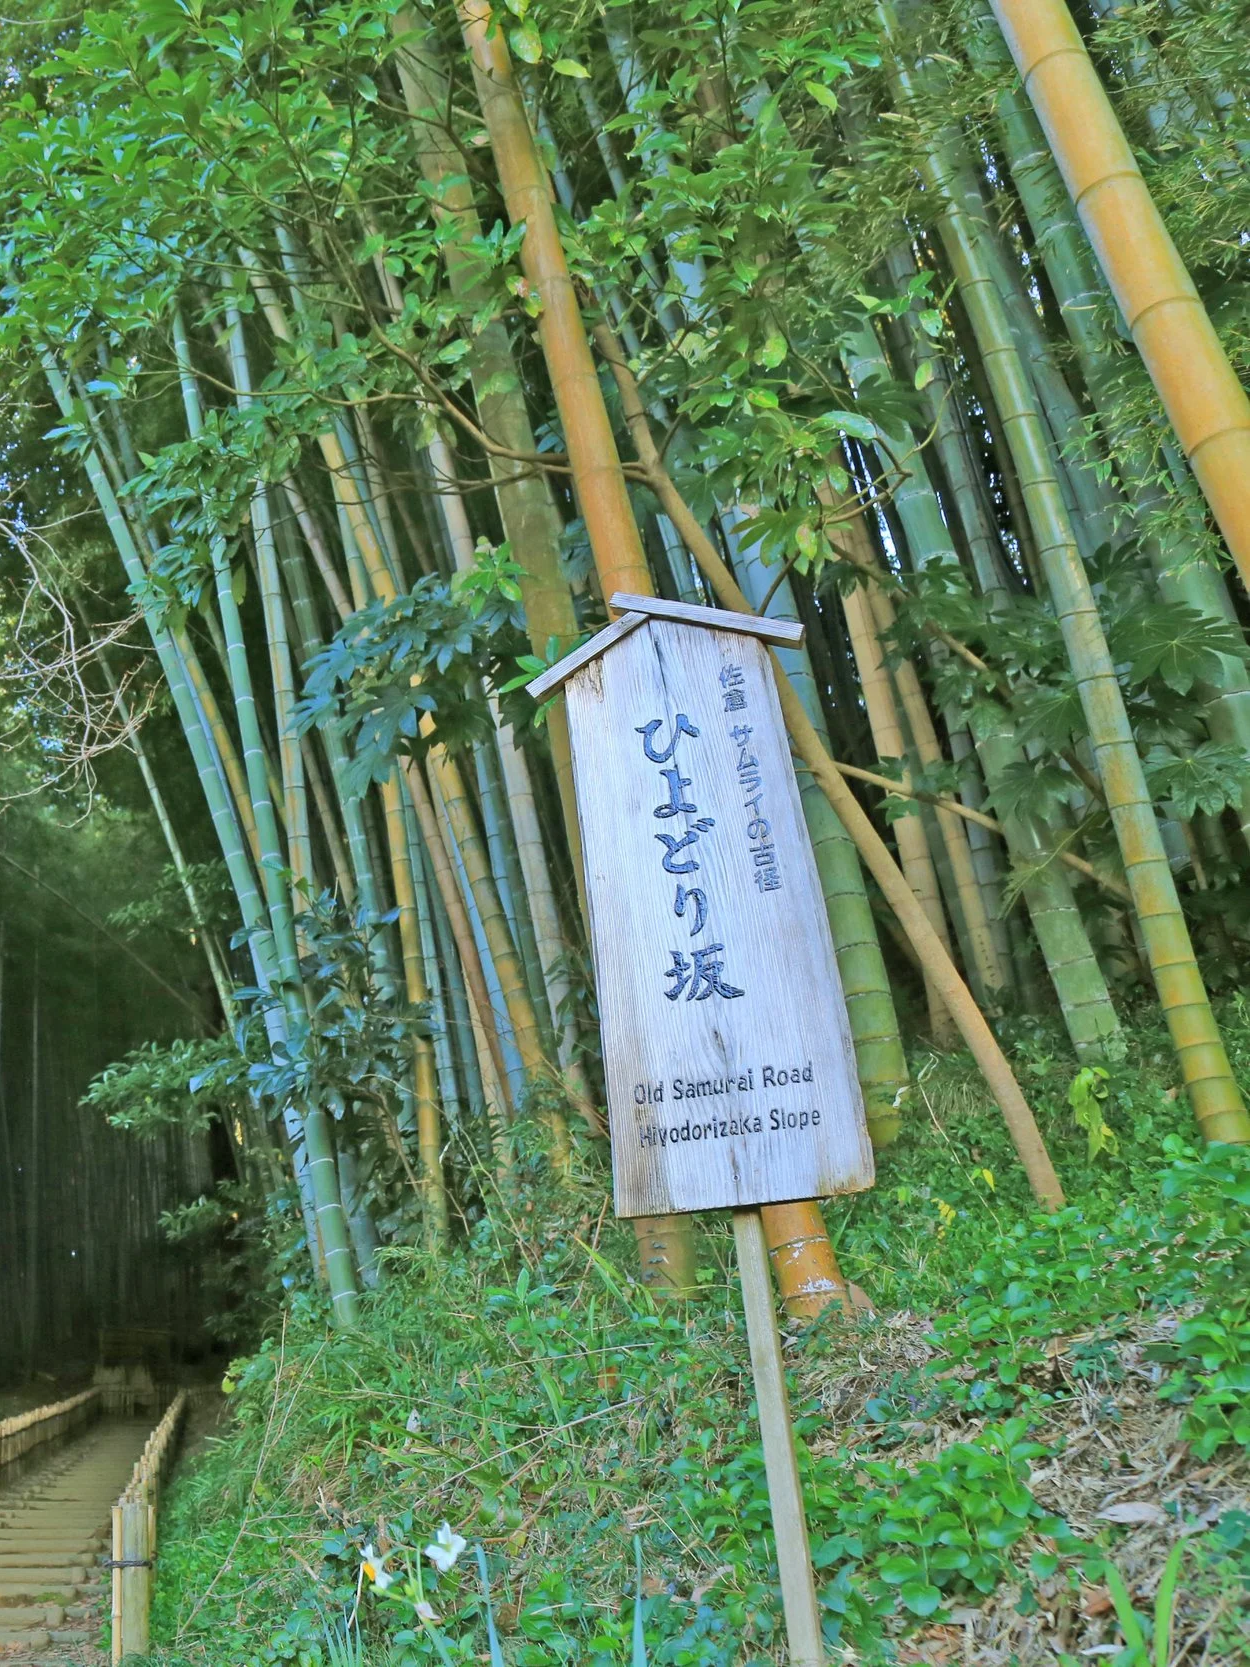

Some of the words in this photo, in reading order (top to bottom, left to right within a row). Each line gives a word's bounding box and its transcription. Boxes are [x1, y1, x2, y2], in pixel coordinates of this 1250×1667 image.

[719, 664, 748, 712] 佐倉
[635, 713, 745, 1001] ひよどり坂
[634, 1081, 664, 1105] Old
[673, 1069, 754, 1101] Samurai
[763, 1061, 813, 1088] Road
[640, 1113, 762, 1149] Hiyodorizaka
[770, 1108, 821, 1132] Slope
